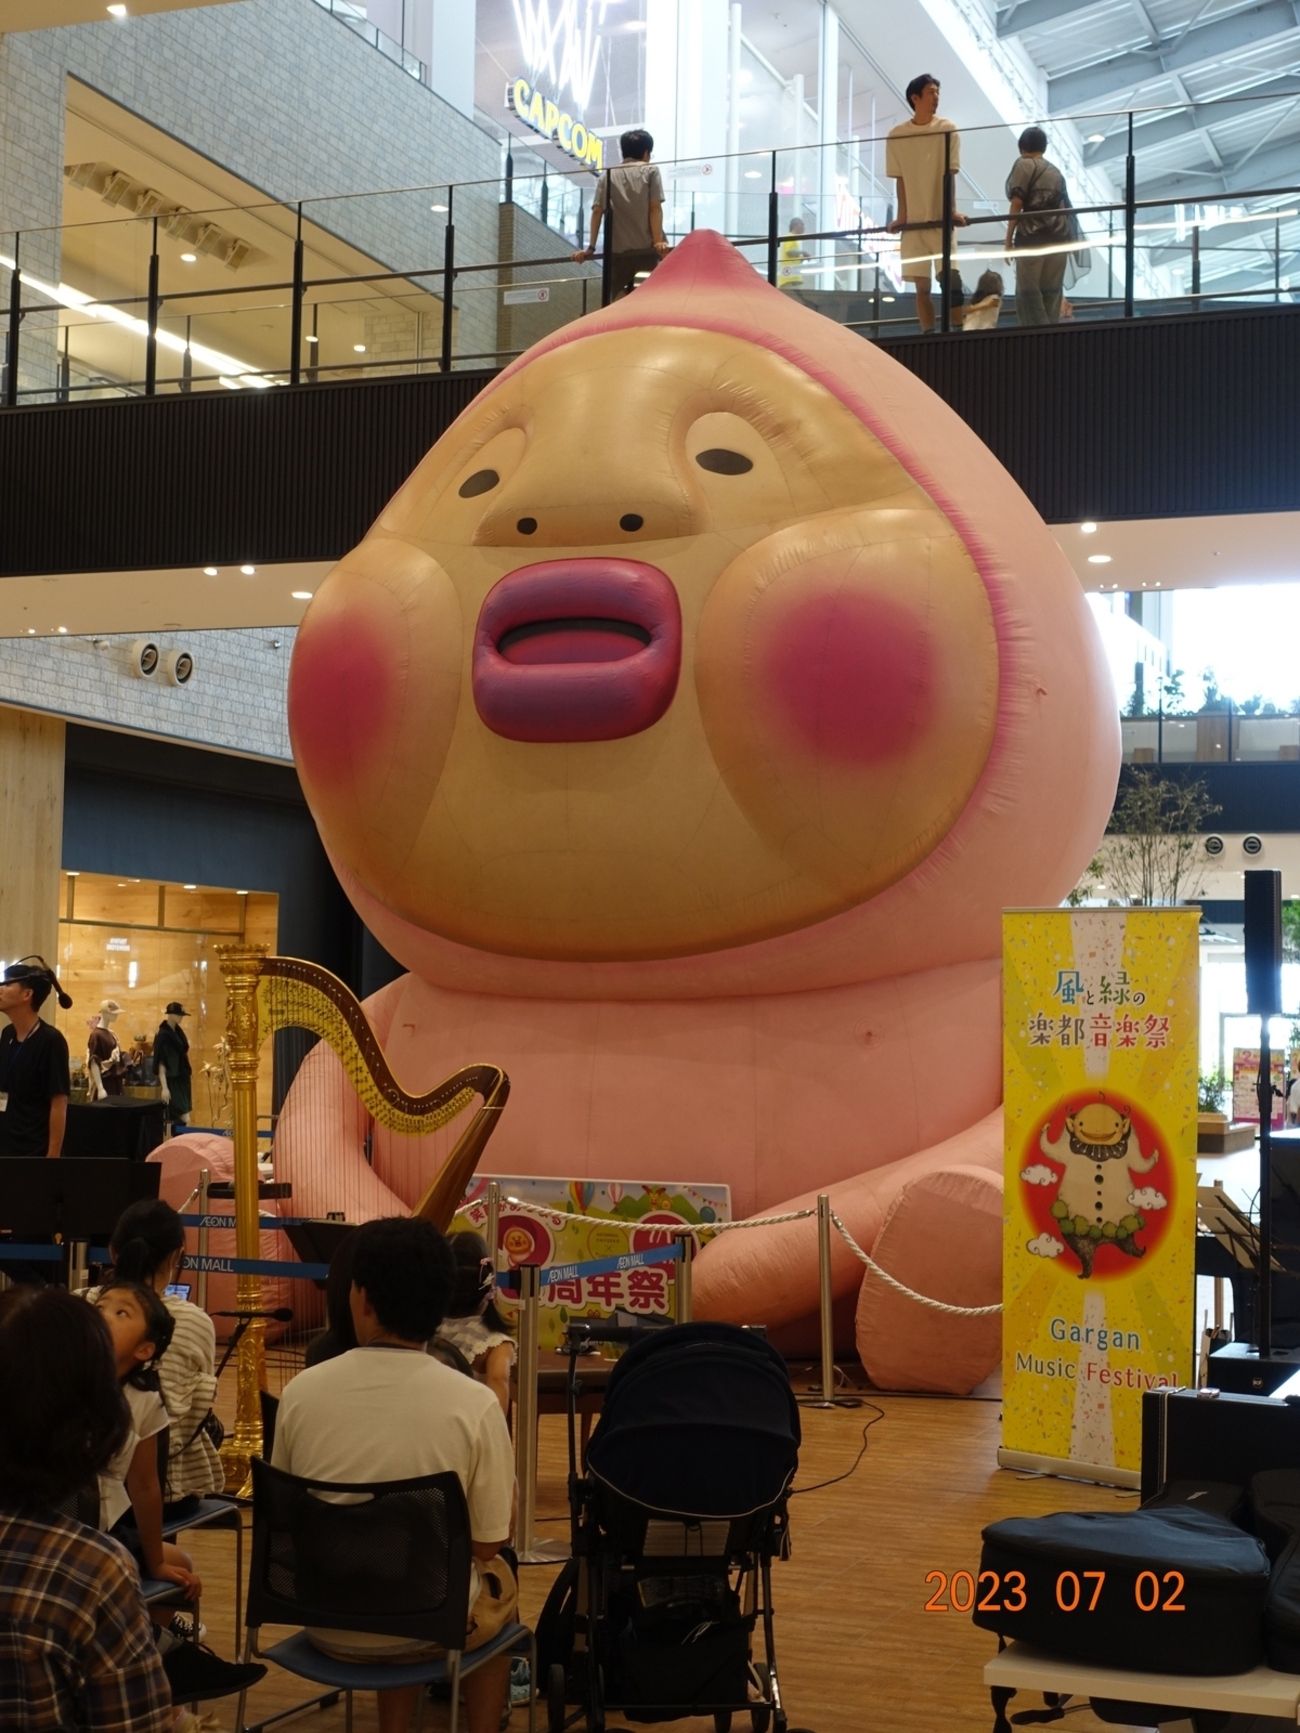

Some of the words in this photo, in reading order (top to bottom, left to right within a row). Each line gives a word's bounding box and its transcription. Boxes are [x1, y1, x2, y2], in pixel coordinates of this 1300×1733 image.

[513, 79, 603, 173] CAPCOM
[1053, 970, 1146, 1006] 風と緑の
[1029, 1012, 1170, 1049] 楽都音楽祭
[201, 1259, 234, 1272] MALL
[563, 1265, 579, 1280] MALL
[630, 1254, 645, 1266] MALL
[547, 1267, 666, 1310] 周年祭
[1051, 1318, 1140, 1351] Gargan
[1016, 1352, 1077, 1379] Music
[1086, 1362, 1179, 1391] Festival
